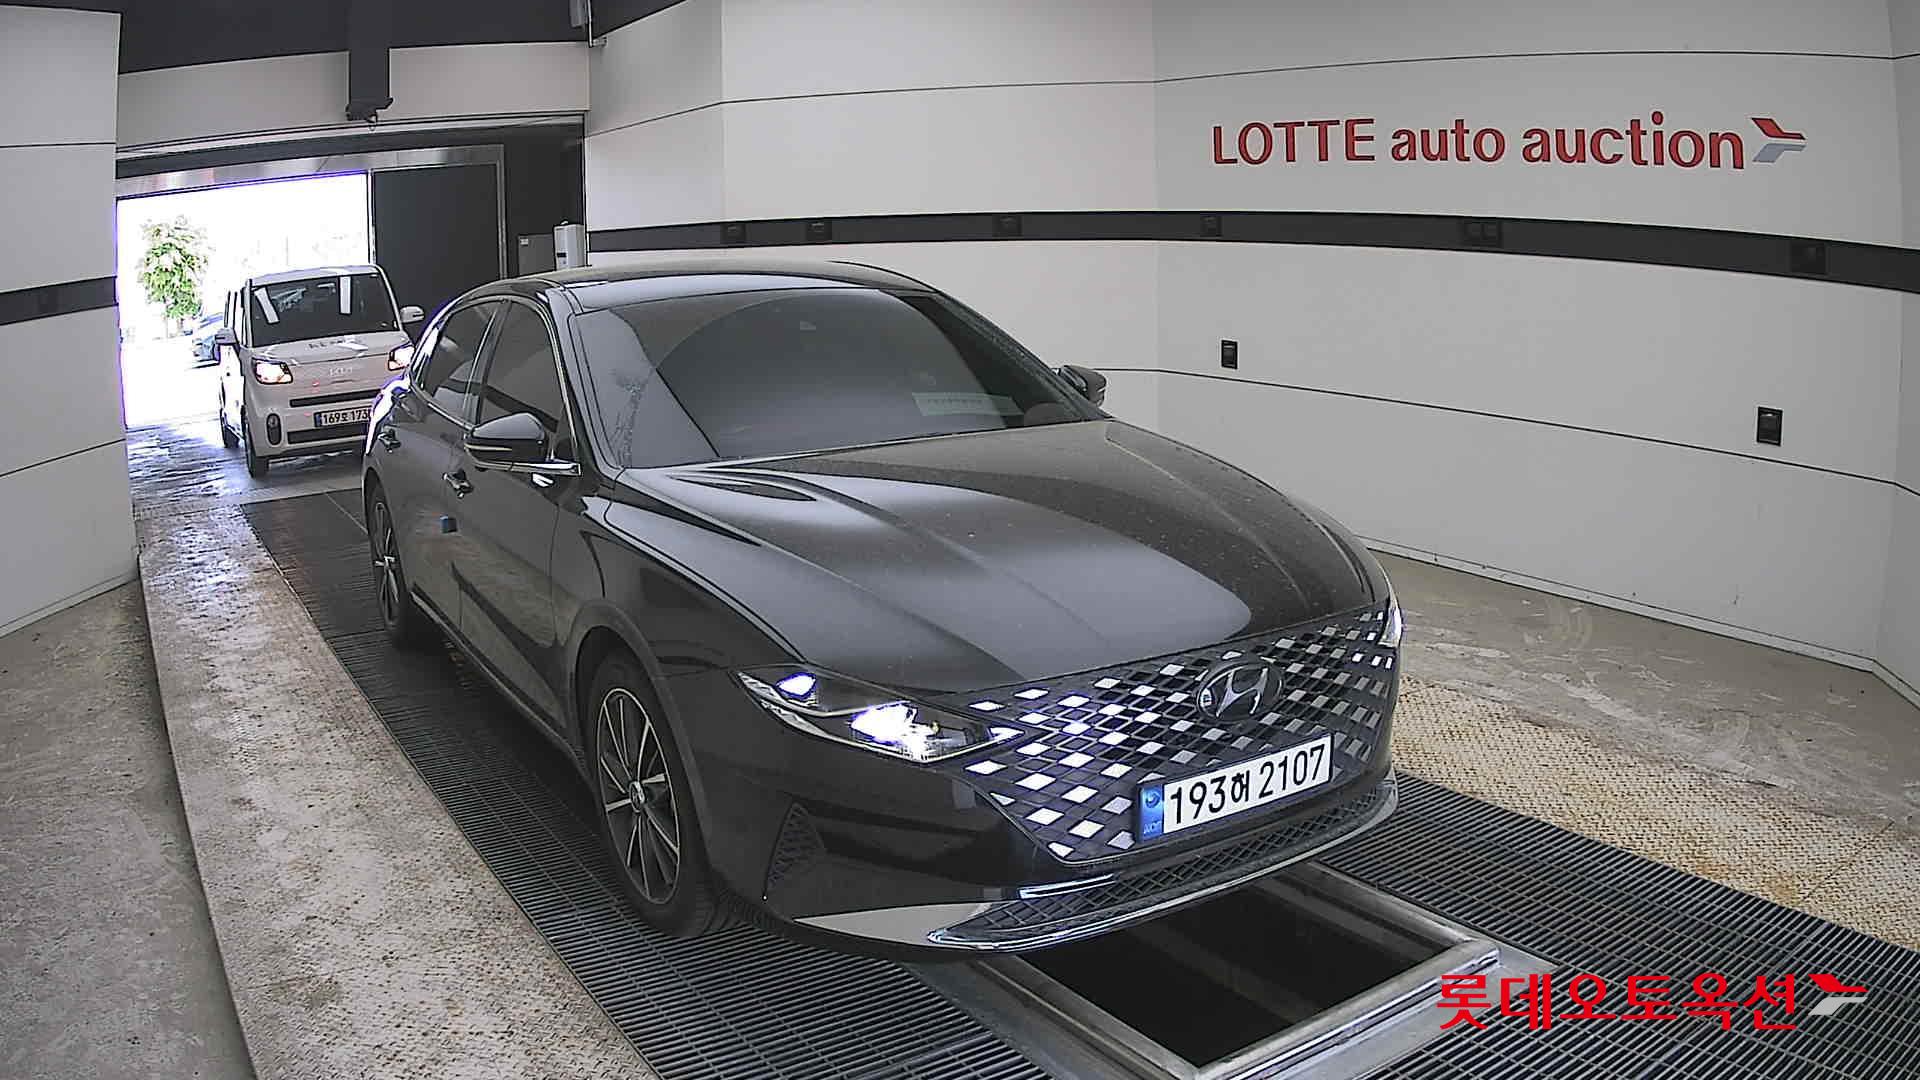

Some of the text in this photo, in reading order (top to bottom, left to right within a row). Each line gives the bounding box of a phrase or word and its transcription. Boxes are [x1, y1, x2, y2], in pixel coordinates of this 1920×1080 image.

[1213, 111, 1745, 170] LOTTE auto auction
[351, 408, 371, 421] 173
[1170, 744, 1326, 824] 193허 2107
